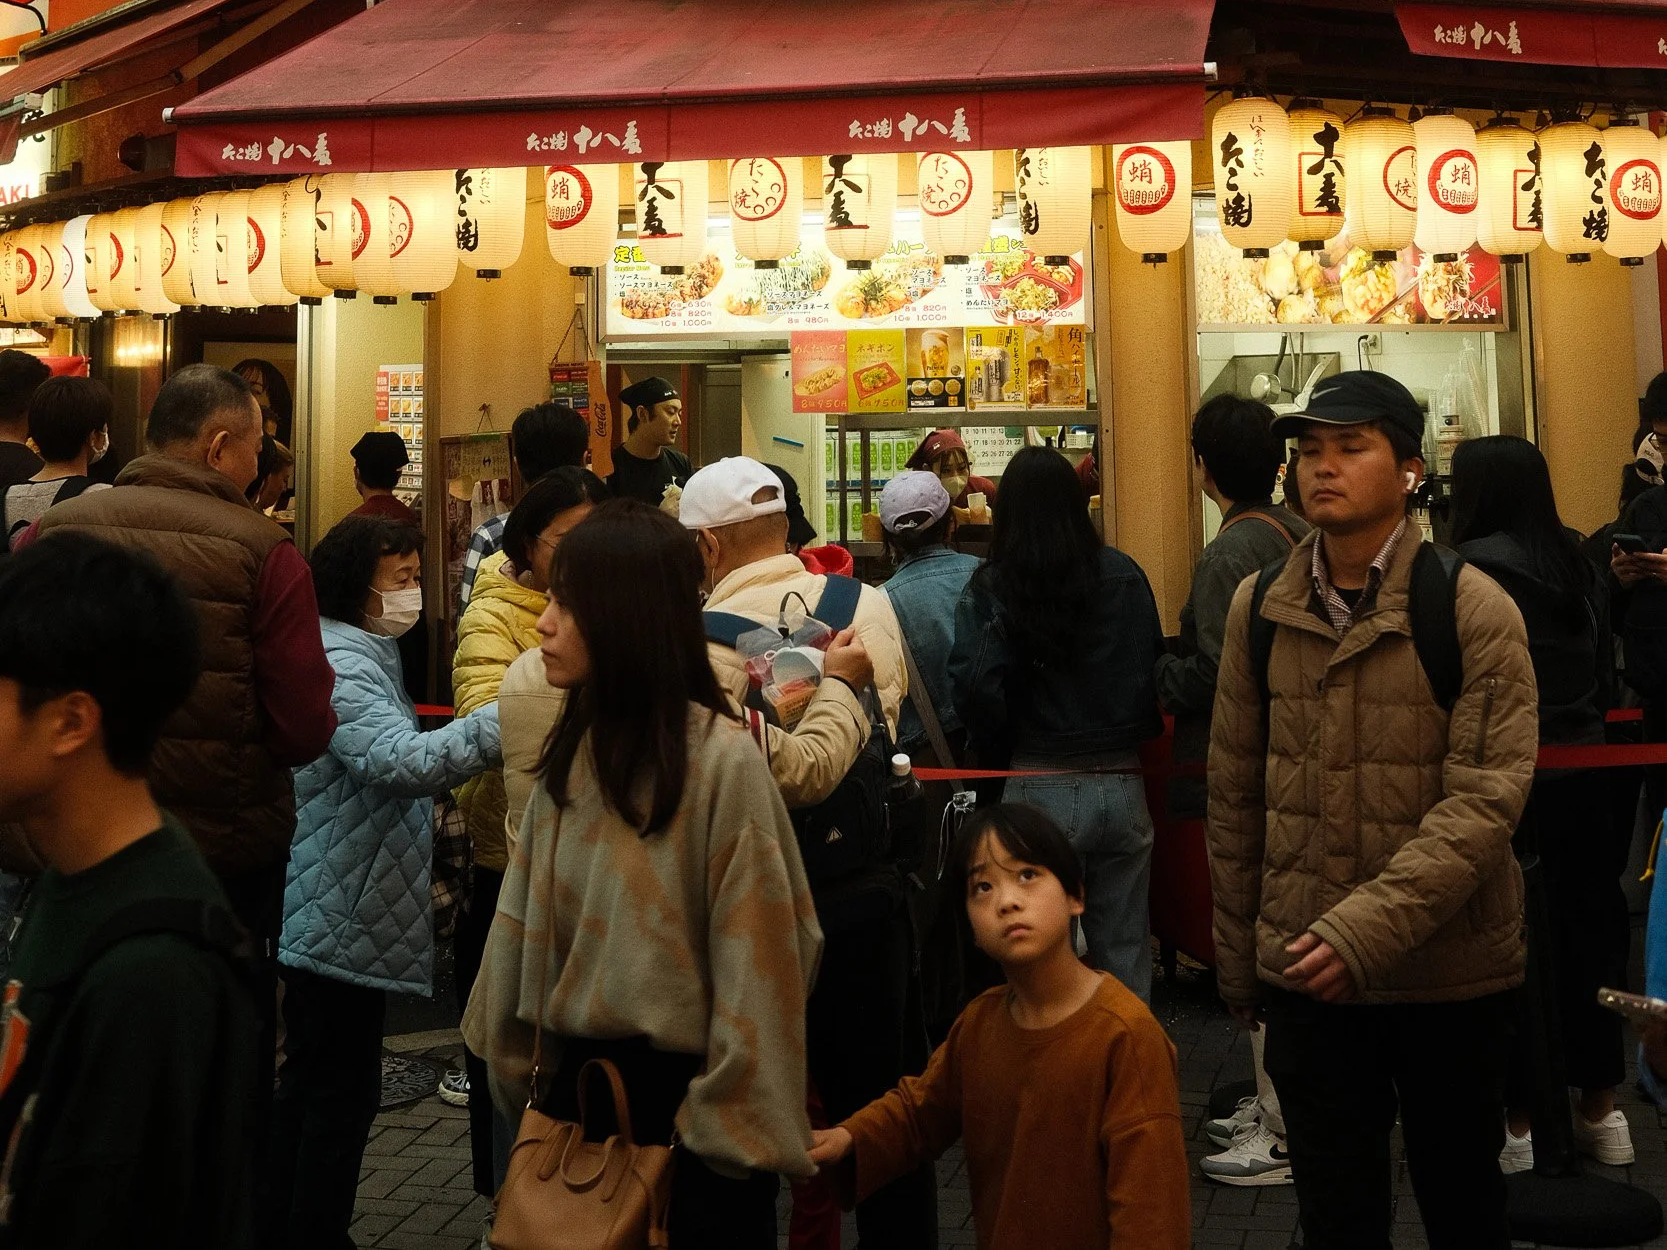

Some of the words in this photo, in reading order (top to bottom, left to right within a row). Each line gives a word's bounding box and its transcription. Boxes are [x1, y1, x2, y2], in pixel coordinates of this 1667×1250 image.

[1128, 159, 1153, 185] 蛸
[1450, 163, 1471, 187] 蛸
[1631, 171, 1652, 194] 蛸
[551, 177, 569, 201] 蛸
